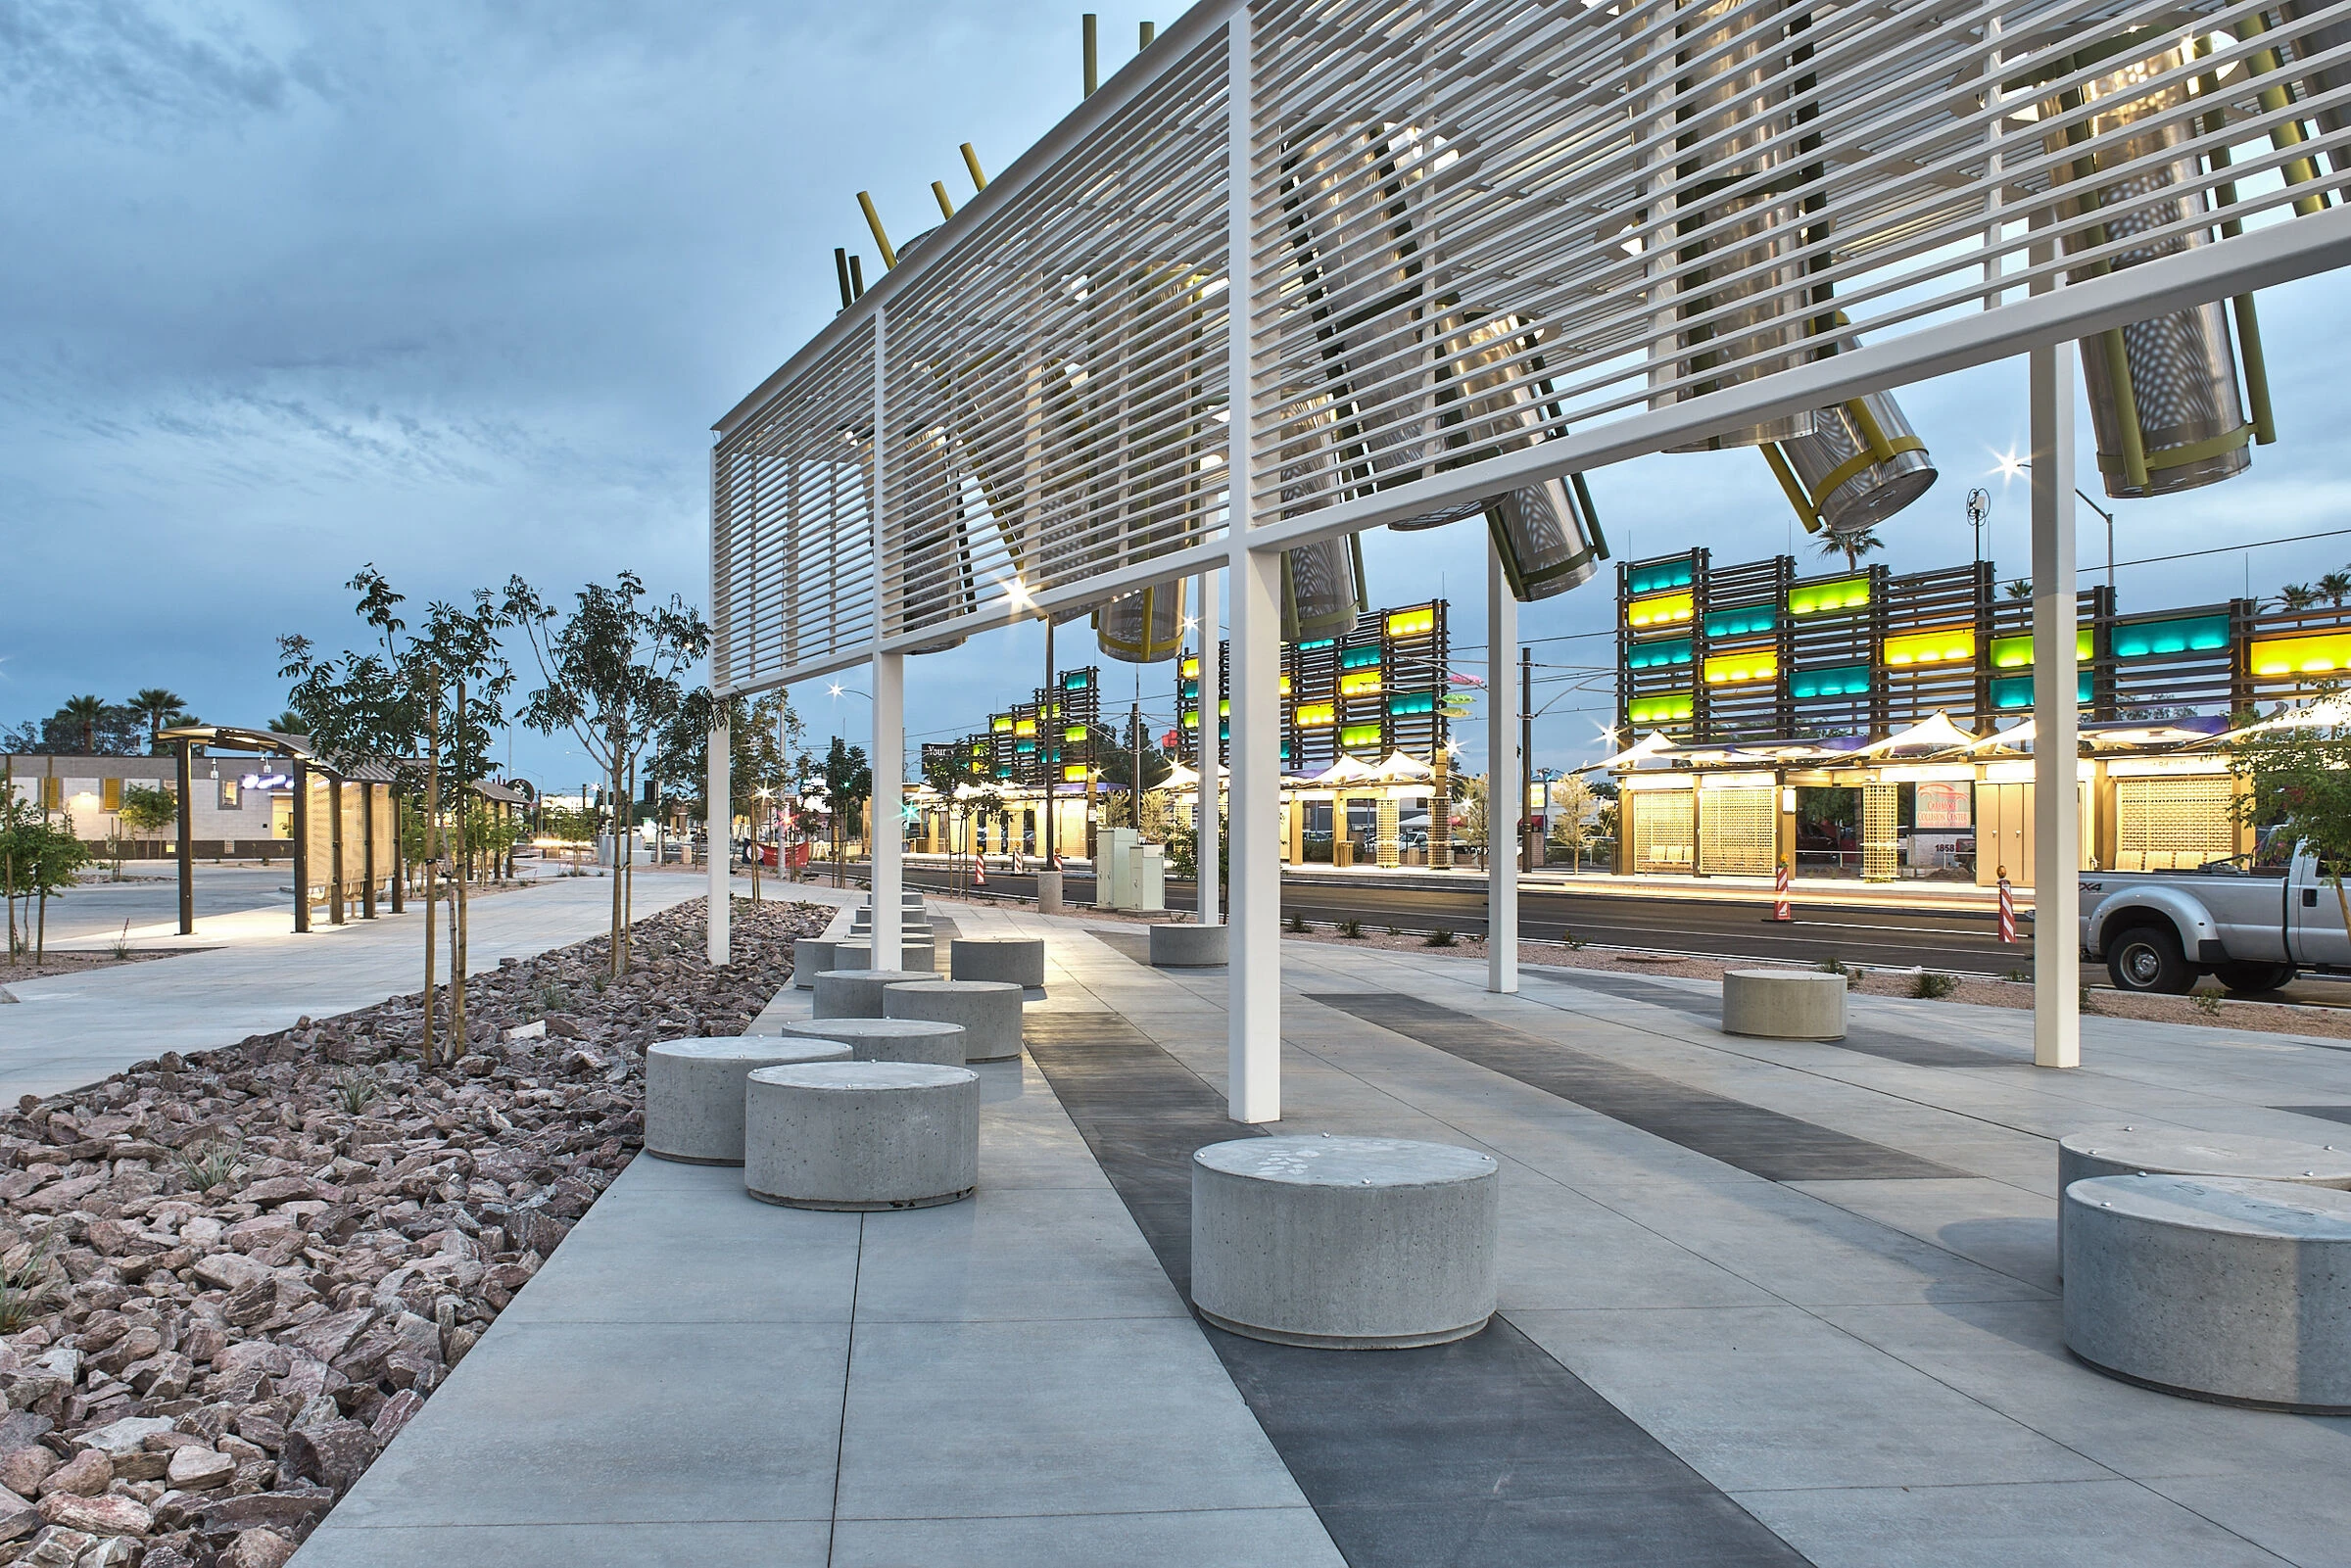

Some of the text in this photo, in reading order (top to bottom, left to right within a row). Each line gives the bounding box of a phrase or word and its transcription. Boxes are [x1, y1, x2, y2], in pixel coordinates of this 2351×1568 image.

[928, 745, 946, 755] Your
[1935, 843, 1955, 852] 1858
[2079, 882, 2102, 891] X4
